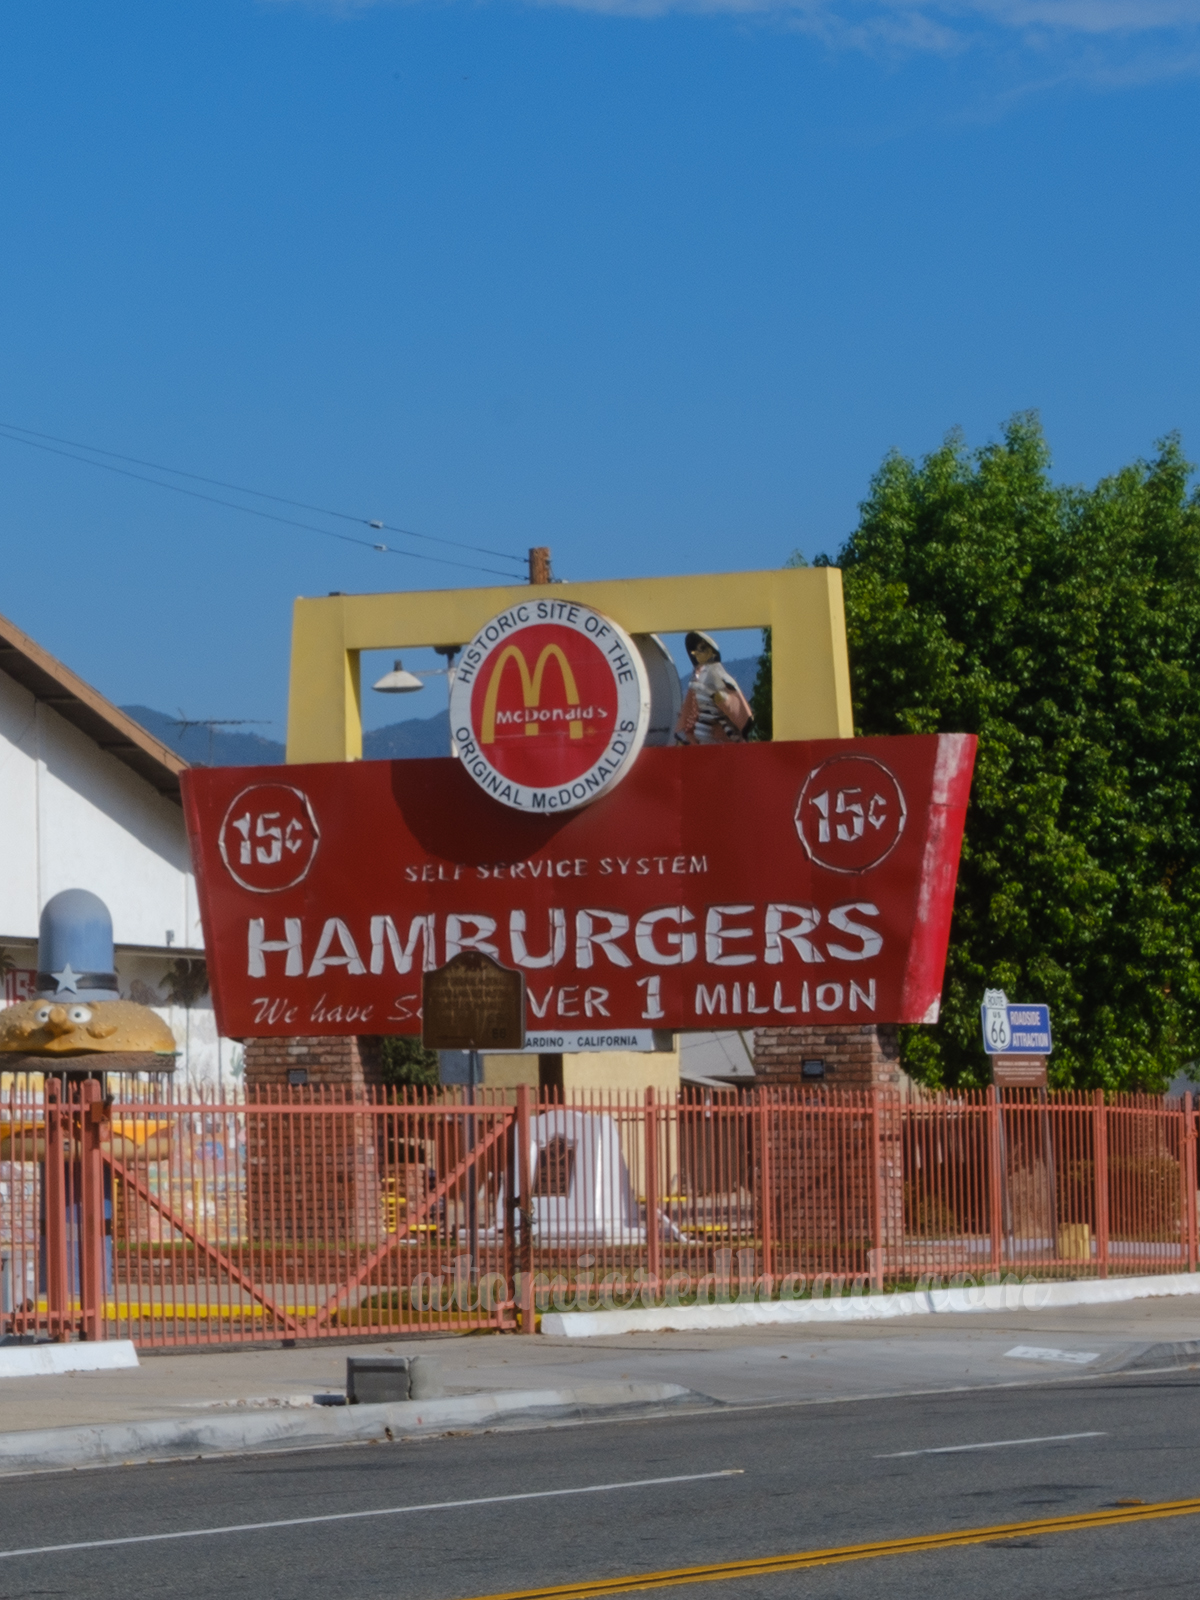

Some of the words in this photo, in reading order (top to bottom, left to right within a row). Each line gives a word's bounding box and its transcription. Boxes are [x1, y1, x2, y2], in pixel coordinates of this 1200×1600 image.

[458, 605, 530, 684] HISTORIC
[537, 602, 580, 624] SITE
[584, 616, 611, 639] OF
[607, 640, 634, 685] THE
[496, 705, 608, 725] McDonald's
[455, 726, 523, 806] ORIGINAL
[531, 719, 635, 809] McDONALD'S
[404, 863, 463, 882] SELF
[476, 858, 588, 880] SERVICE
[598, 855, 709, 875] SYSTEM
[247, 902, 884, 978] HAMBURGERS
[250, 996, 300, 1026] We
[309, 993, 374, 1023] have
[526, 984, 611, 1019] VER
[636, 975, 665, 1019] 1
[695, 977, 877, 1015] MILLION
[987, 995, 1004, 1007] ROUTE
[992, 1011, 1002, 1019] US
[1009, 1011, 1041, 1026] ROADSIDE
[526, 1036, 564, 1048] ARDINO
[576, 1035, 638, 1047] CALIFORNIA
[991, 1021, 1006, 1044] 66
[1012, 1032, 1049, 1047] ATTRACTION
